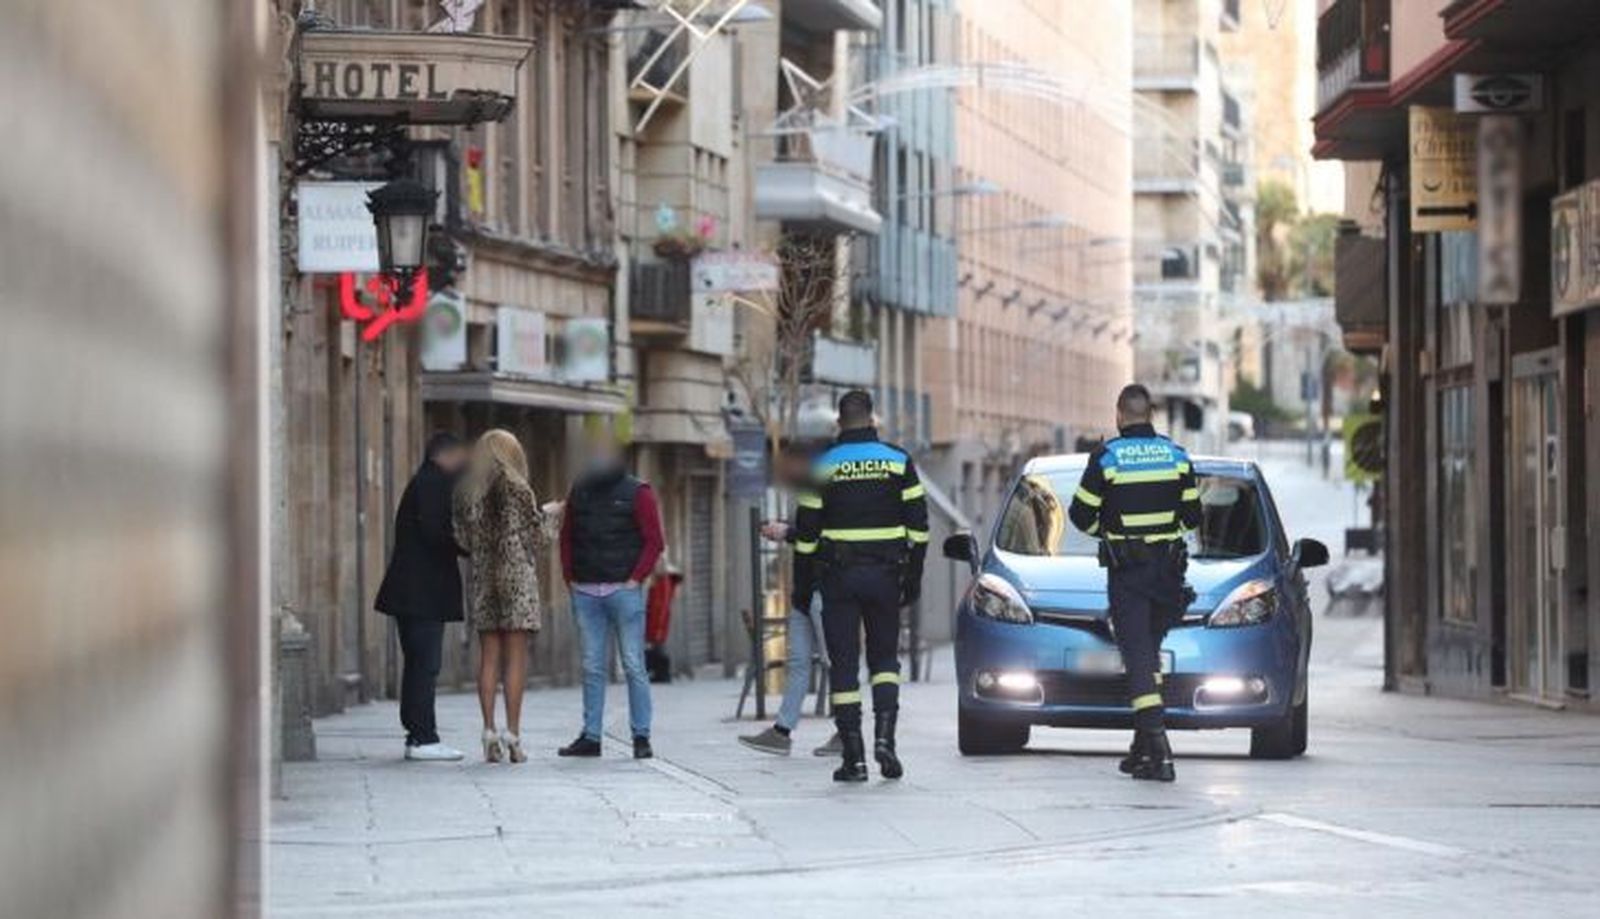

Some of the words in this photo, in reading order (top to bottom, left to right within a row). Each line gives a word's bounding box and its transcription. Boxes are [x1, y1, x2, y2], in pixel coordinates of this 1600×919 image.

[314, 62, 447, 99] HOTEL
[312, 234, 375, 251] RUIPE
[1115, 445, 1171, 458] POLICIA
